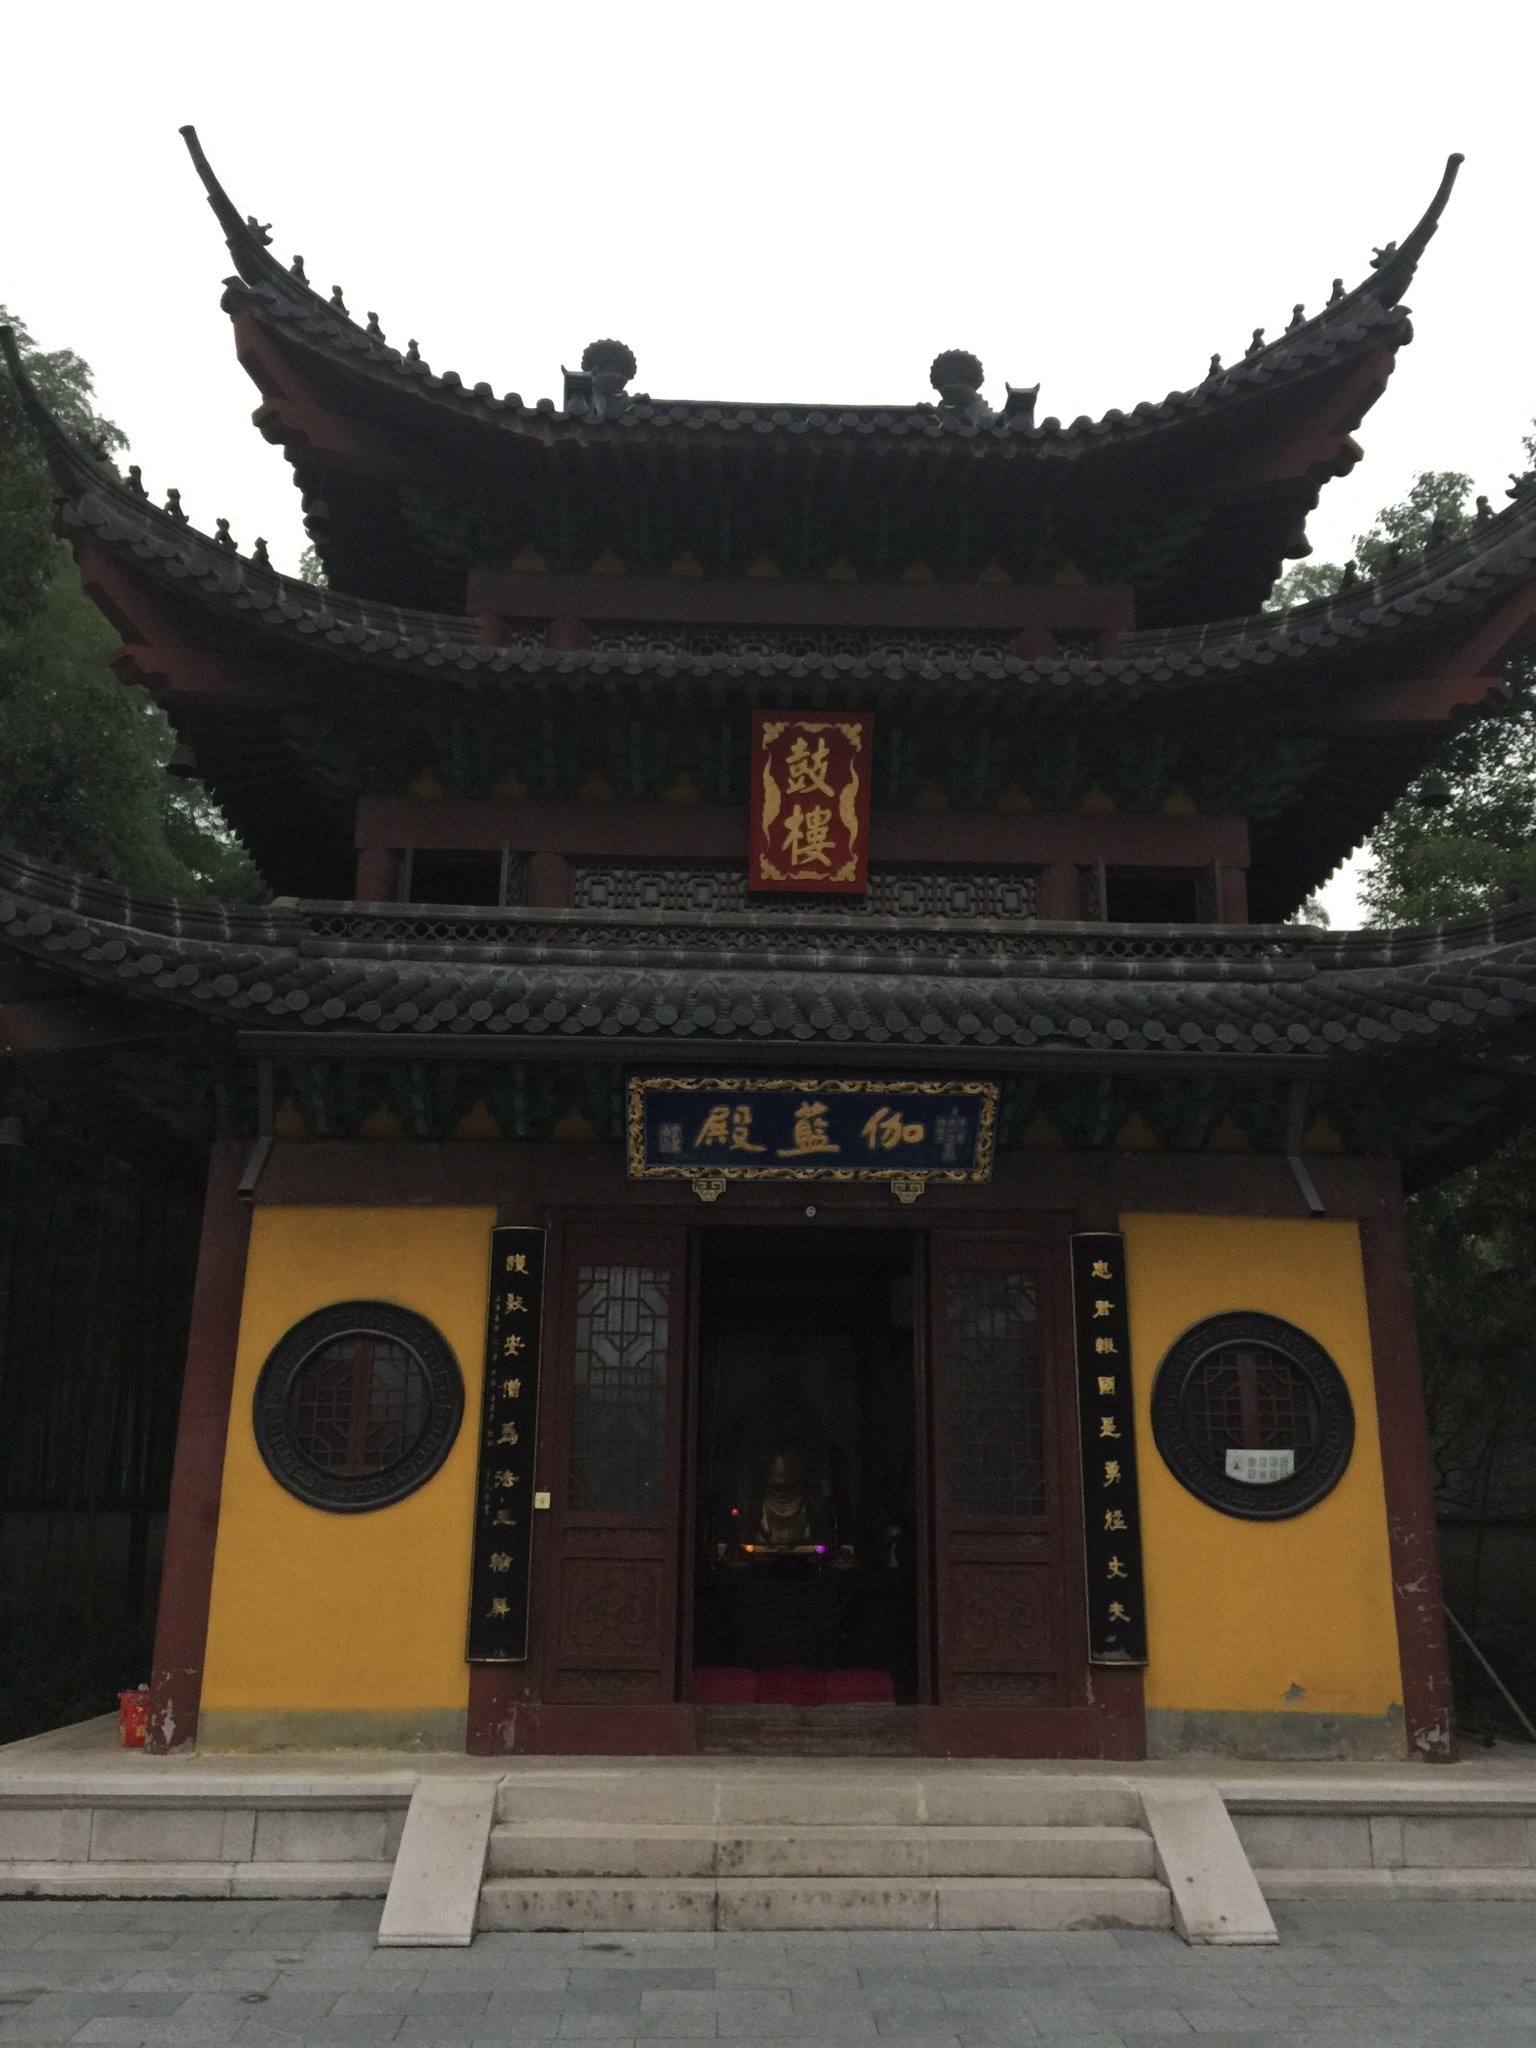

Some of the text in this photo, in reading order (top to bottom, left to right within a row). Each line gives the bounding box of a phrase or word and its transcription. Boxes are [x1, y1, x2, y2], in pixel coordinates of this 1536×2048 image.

[782, 737, 836, 866] 鼓樓
[694, 1100, 926, 1157] 伽藍殿
